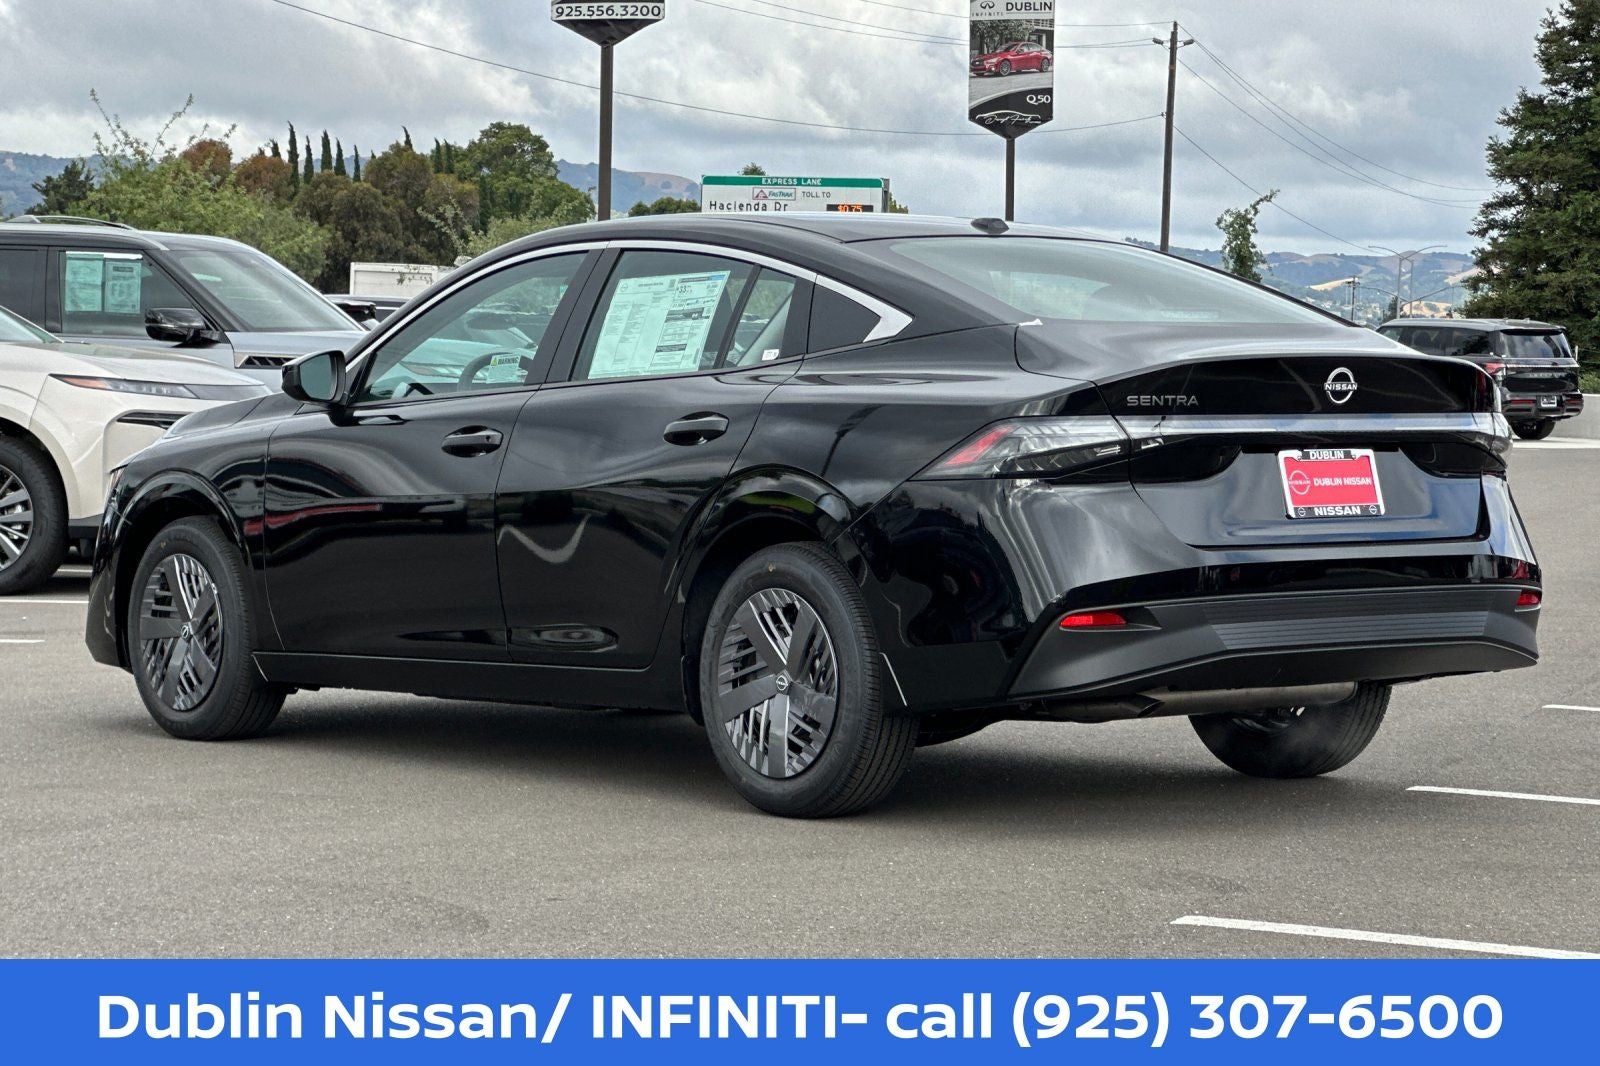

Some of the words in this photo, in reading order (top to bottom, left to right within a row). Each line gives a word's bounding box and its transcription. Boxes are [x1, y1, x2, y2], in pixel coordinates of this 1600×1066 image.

[1005, 2, 1053, 11] DUBLIN
[555, 5, 661, 18] 925.556.3200
[1026, 94, 1051, 105] Q50
[801, 178, 822, 186] LANE
[822, 191, 832, 199] TO
[709, 201, 767, 212] Hacienda
[774, 201, 788, 212] Dr
[1126, 395, 1199, 406] SENTRA
[1310, 450, 1344, 460] DUBLIN
[1313, 477, 1343, 486] DUBLIN
[1343, 477, 1373, 485] NISSAN
[1314, 506, 1361, 515] NISSAN
